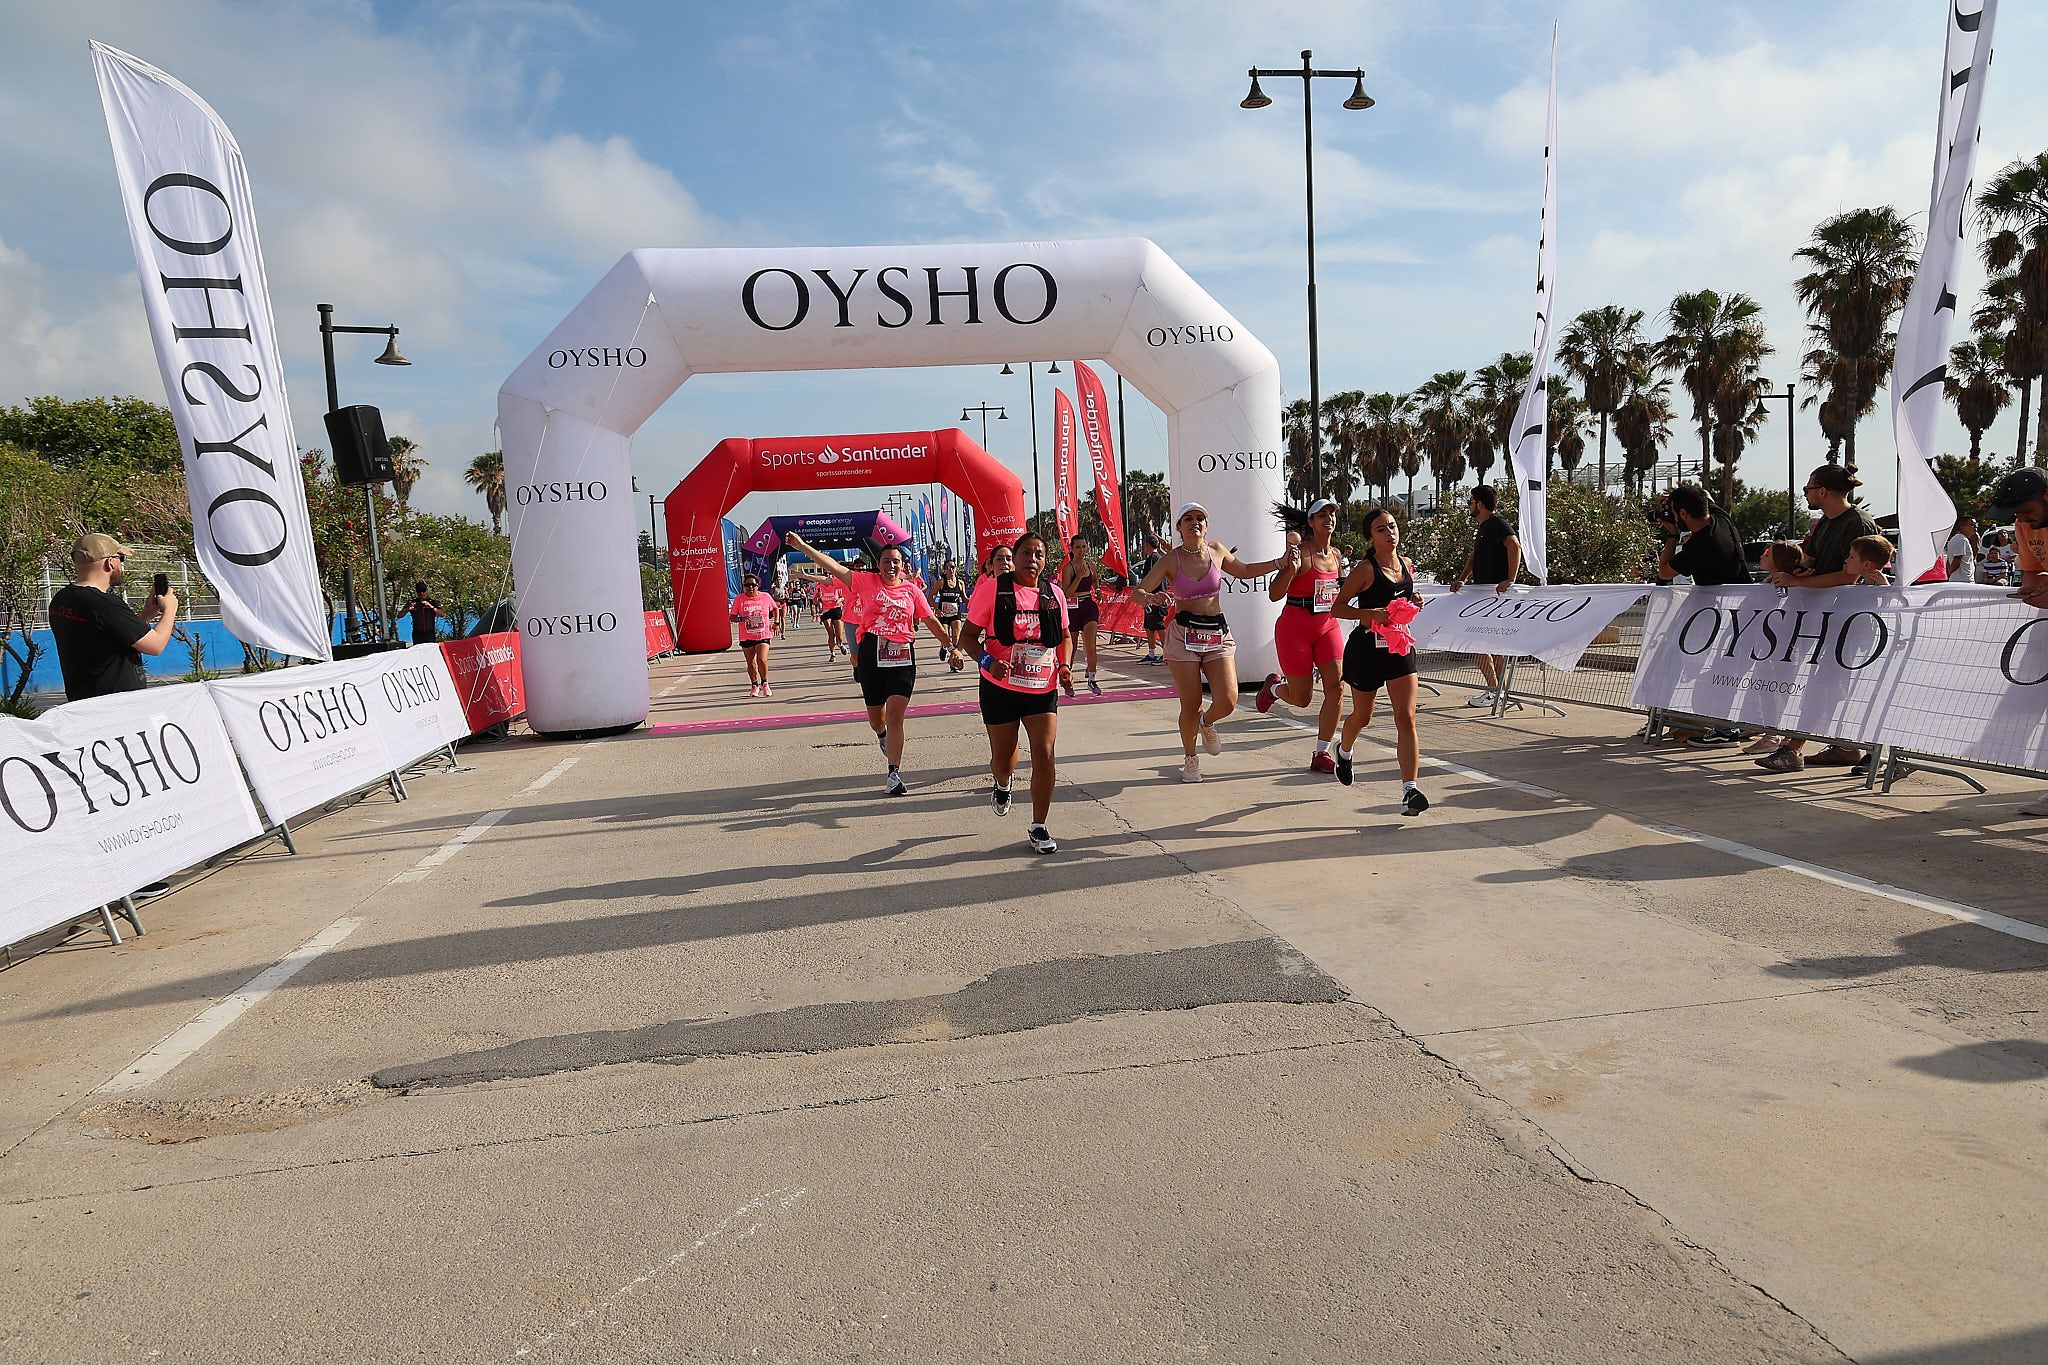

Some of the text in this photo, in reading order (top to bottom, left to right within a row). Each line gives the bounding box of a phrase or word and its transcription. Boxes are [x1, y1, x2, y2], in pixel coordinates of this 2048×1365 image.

[741, 263, 1059, 330] OYSHO
[1147, 325, 1234, 347] OYSHO
[548, 347, 647, 369] OYSHO
[761, 444, 928, 470] Sports Santander
[1198, 451, 1277, 473] OYSHO
[816, 468, 873, 477] sportssantander.es
[516, 481, 608, 505] OYSHO
[991, 515, 1016, 525] Sports
[681, 535, 707, 545] Sports
[991, 527, 1025, 536] Santander
[680, 546, 718, 556] Santander
[1221, 572, 1278, 594] YSH
[527, 612, 617, 637] OYSHO
[1678, 607, 1889, 671] OYSHO
[1025, 664, 1042, 673] 016
[381, 664, 440, 713] OYSHO
[1712, 674, 1806, 695] WWW.OYSHO.COM
[259, 682, 367, 752] OYSHO
[0, 722, 201, 833] OYSHO
[98, 812, 185, 854] WWW.OYSHO.COM
